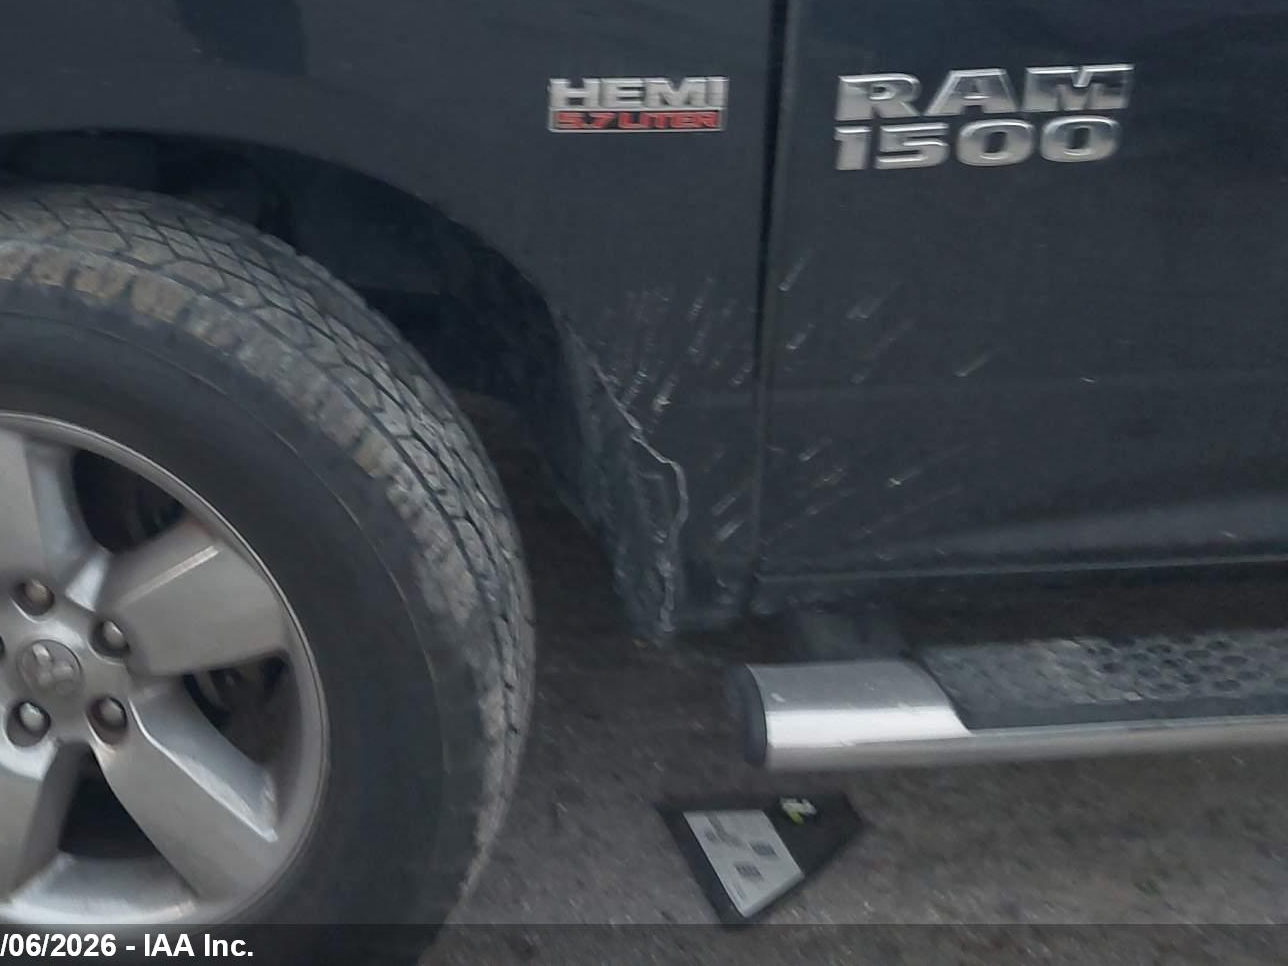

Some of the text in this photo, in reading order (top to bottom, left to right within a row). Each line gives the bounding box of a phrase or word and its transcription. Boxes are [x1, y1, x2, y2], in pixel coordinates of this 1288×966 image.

[548, 76, 729, 108] HEMI
[834, 64, 1134, 121] RAM
[554, 109, 720, 129] 5.7 LITER
[834, 115, 1120, 171] 1500
